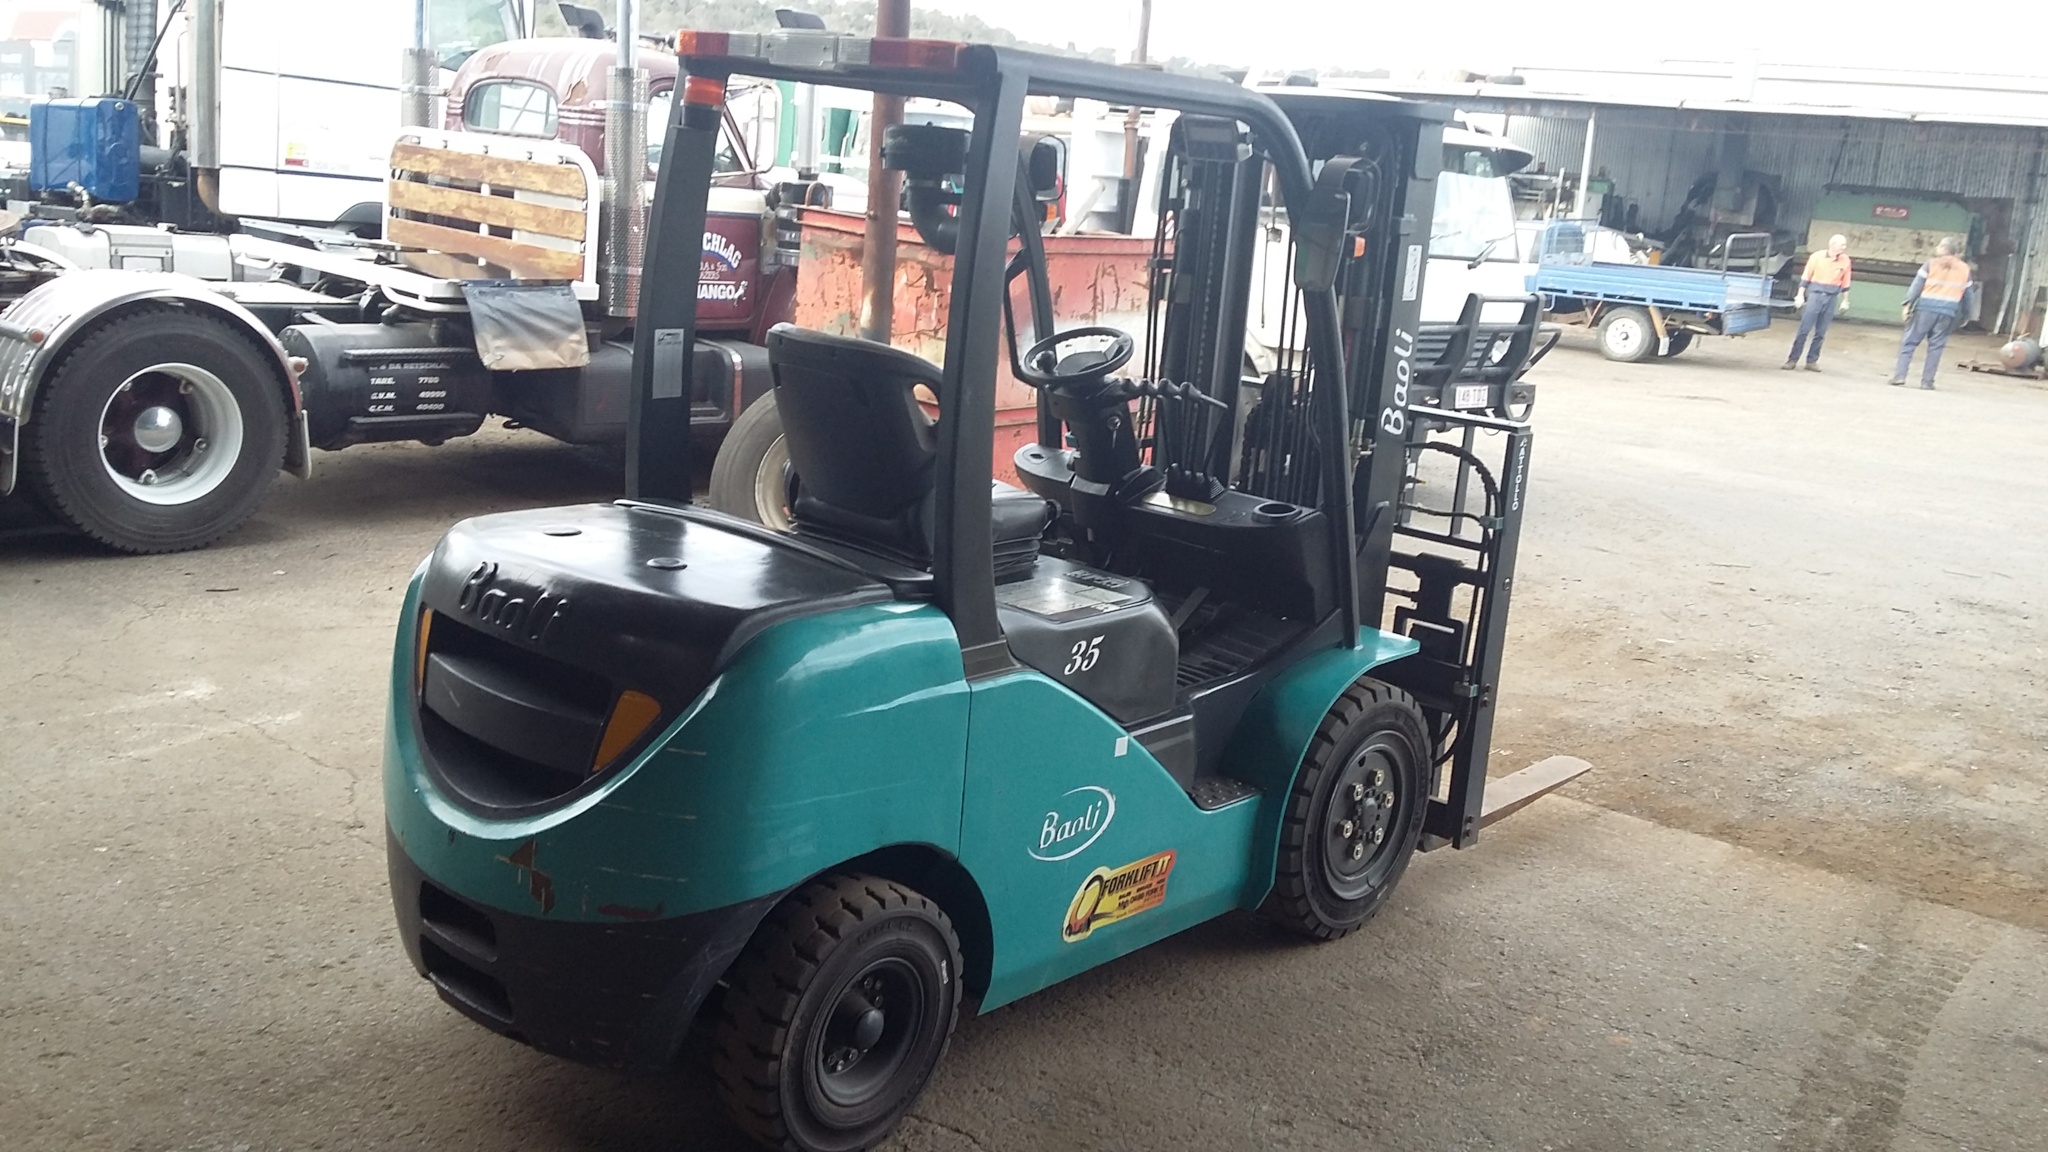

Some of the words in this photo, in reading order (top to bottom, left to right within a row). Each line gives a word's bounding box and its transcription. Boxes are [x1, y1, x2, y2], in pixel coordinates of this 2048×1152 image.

[702, 231, 742, 269] CHLAG
[1380, 327, 1414, 435] Baoli
[458, 560, 569, 640] Baoli
[1063, 634, 1106, 676] 35
[1039, 799, 1103, 849] Baoli
[1101, 860, 1160, 898] FORKLIFT
